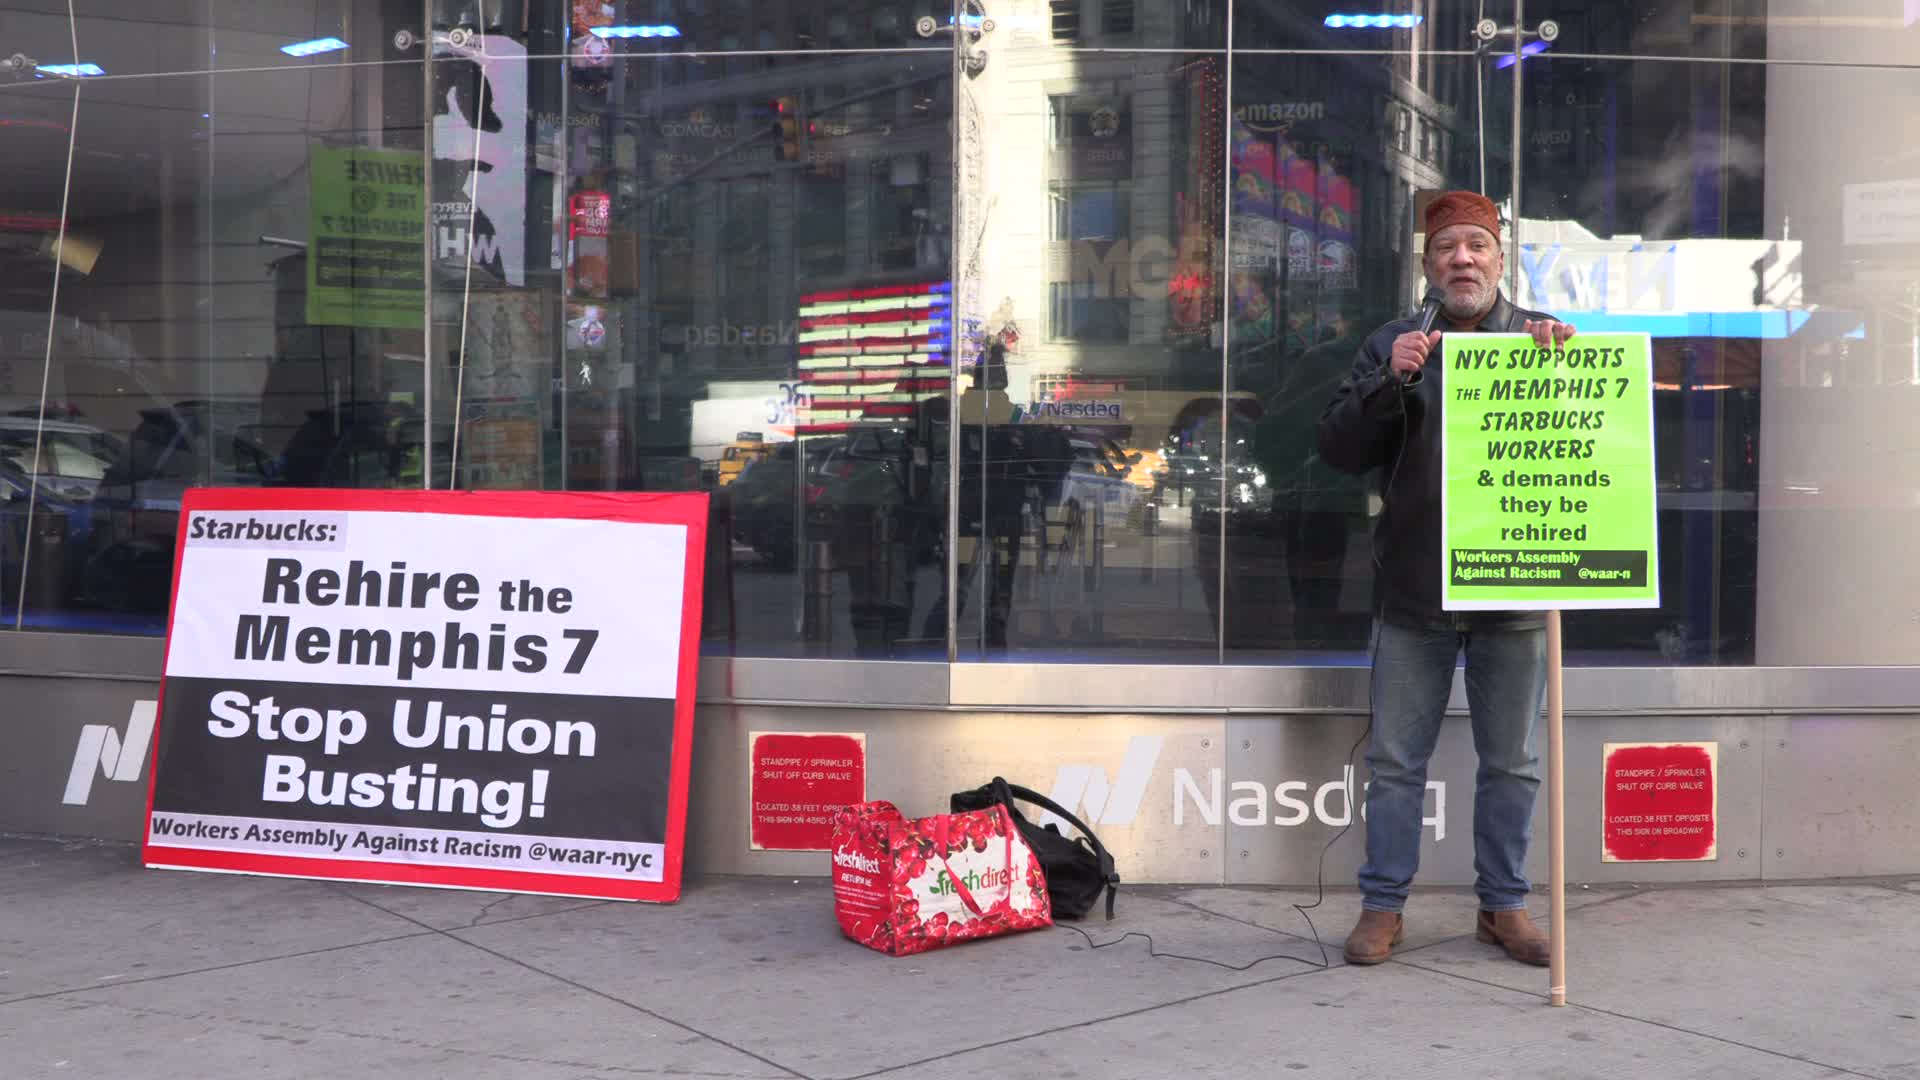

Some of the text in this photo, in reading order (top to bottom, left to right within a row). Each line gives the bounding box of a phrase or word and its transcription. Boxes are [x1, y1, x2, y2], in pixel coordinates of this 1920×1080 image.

[1235, 102, 1324, 121] amazon
[1455, 348, 1625, 370] NYC SUPPORTS
[1456, 378, 1630, 401] THE MEMPHIS 7
[1480, 410, 1605, 432] STARBUCKS
[1487, 440, 1595, 461] WORKERS
[1477, 470, 1611, 488] & demands
[1500, 496, 1588, 517] they be
[190, 516, 337, 543] Starbucks:
[1501, 524, 1587, 541] rehired
[1454, 551, 1581, 566] Workers Assembly
[1454, 566, 1506, 580] Against
[1510, 566, 1561, 579] Racism
[262, 558, 573, 614] Rehire the
[234, 614, 599, 680] Memphis 7
[207, 690, 597, 757] Stop Union
[761, 758, 801, 767] STANDPIPE
[811, 759, 853, 768] SPRINKLER
[762, 771, 852, 781] SHUT OFF CURB VALVE
[1615, 769, 1655, 778] STANDPIPE
[1664, 768, 1706, 777] SPRINKLER
[262, 754, 550, 828] Busting!
[1616, 782, 1704, 791] SHUT OFF CURB VALVE
[756, 802, 789, 812] LOCATED
[791, 803, 802, 812] 38
[803, 804, 821, 812] FEET
[1173, 764, 1446, 841] Nasdq
[759, 816, 775, 824] THIS
[775, 816, 793, 824] SIGN
[793, 816, 805, 824] ON
[1609, 814, 1710, 824] LOCATED 38 FEET OPPOSITE
[1616, 827, 1703, 836] THIS SIGN ON BROADWAY
[151, 816, 653, 871] Workers Assembly Against Racism @waar-nyc
